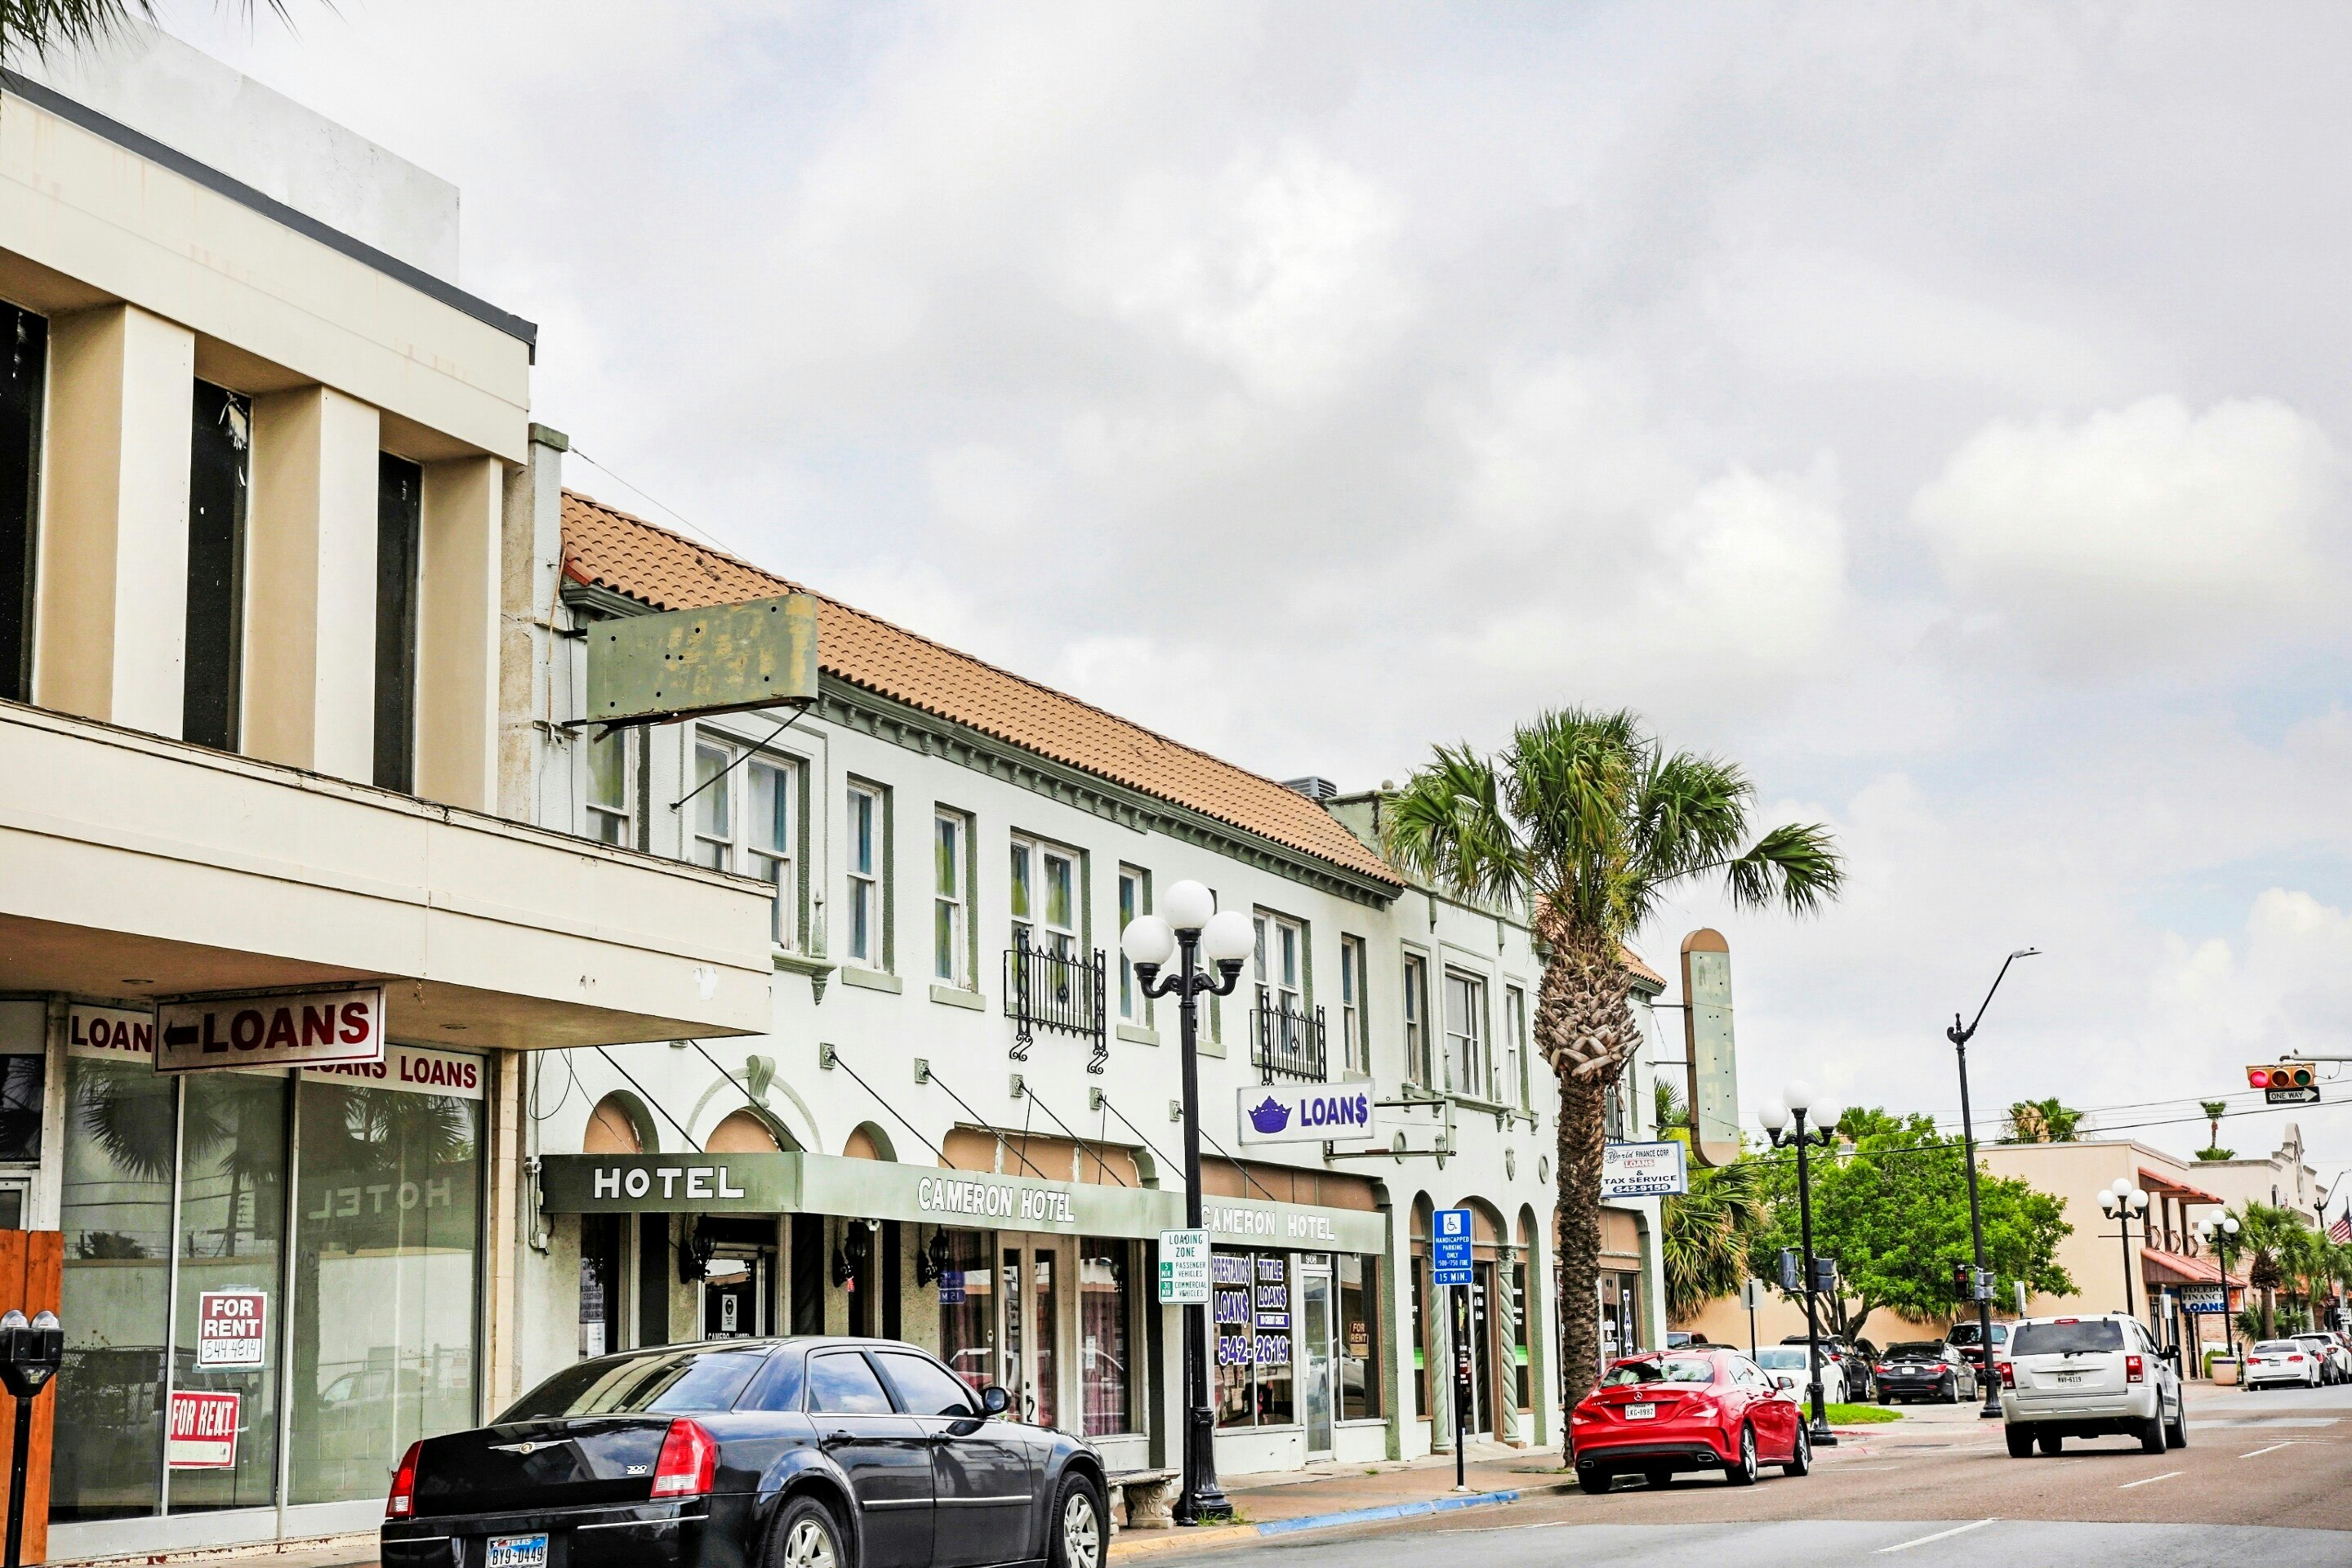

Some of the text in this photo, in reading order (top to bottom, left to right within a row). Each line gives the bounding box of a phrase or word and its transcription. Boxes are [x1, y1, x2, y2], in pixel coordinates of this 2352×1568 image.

[203, 1001, 370, 1054] LOANS
[400, 1055, 477, 1089] LOANS
[1301, 1092, 1368, 1128] LOAN$
[1608, 1151, 1634, 1160] World
[1636, 1150, 1655, 1158] FINANCE
[1625, 1160, 1654, 1168] LOANS
[594, 1166, 745, 1198] HOTEL
[1629, 1175, 1677, 1183] SERVICE
[1615, 1184, 1668, 1192] 542-9156
[918, 1177, 1075, 1223] CAMERON HOTEL
[1201, 1205, 1335, 1241] CAMERON HOTEL
[1169, 1234, 1203, 1245] LOADING
[1176, 1247, 1196, 1258] ZONE
[1306, 1255, 1317, 1264] 908
[1258, 1259, 1283, 1281] TITLE
[1439, 1272, 1468, 1282] 15 MIN.
[1174, 1281, 1207, 1289] COMMERCIAL
[1258, 1284, 1286, 1310] LOAN$
[212, 1298, 254, 1316] FOR
[1215, 1289, 1249, 1328] LOAN$
[204, 1318, 261, 1337] RENT
[1352, 1323, 1365, 1332] FOR
[1351, 1333, 1367, 1343] RENT
[171, 1398, 234, 1437] FOR RENT
[506, 1538, 532, 1547] TEXAS
